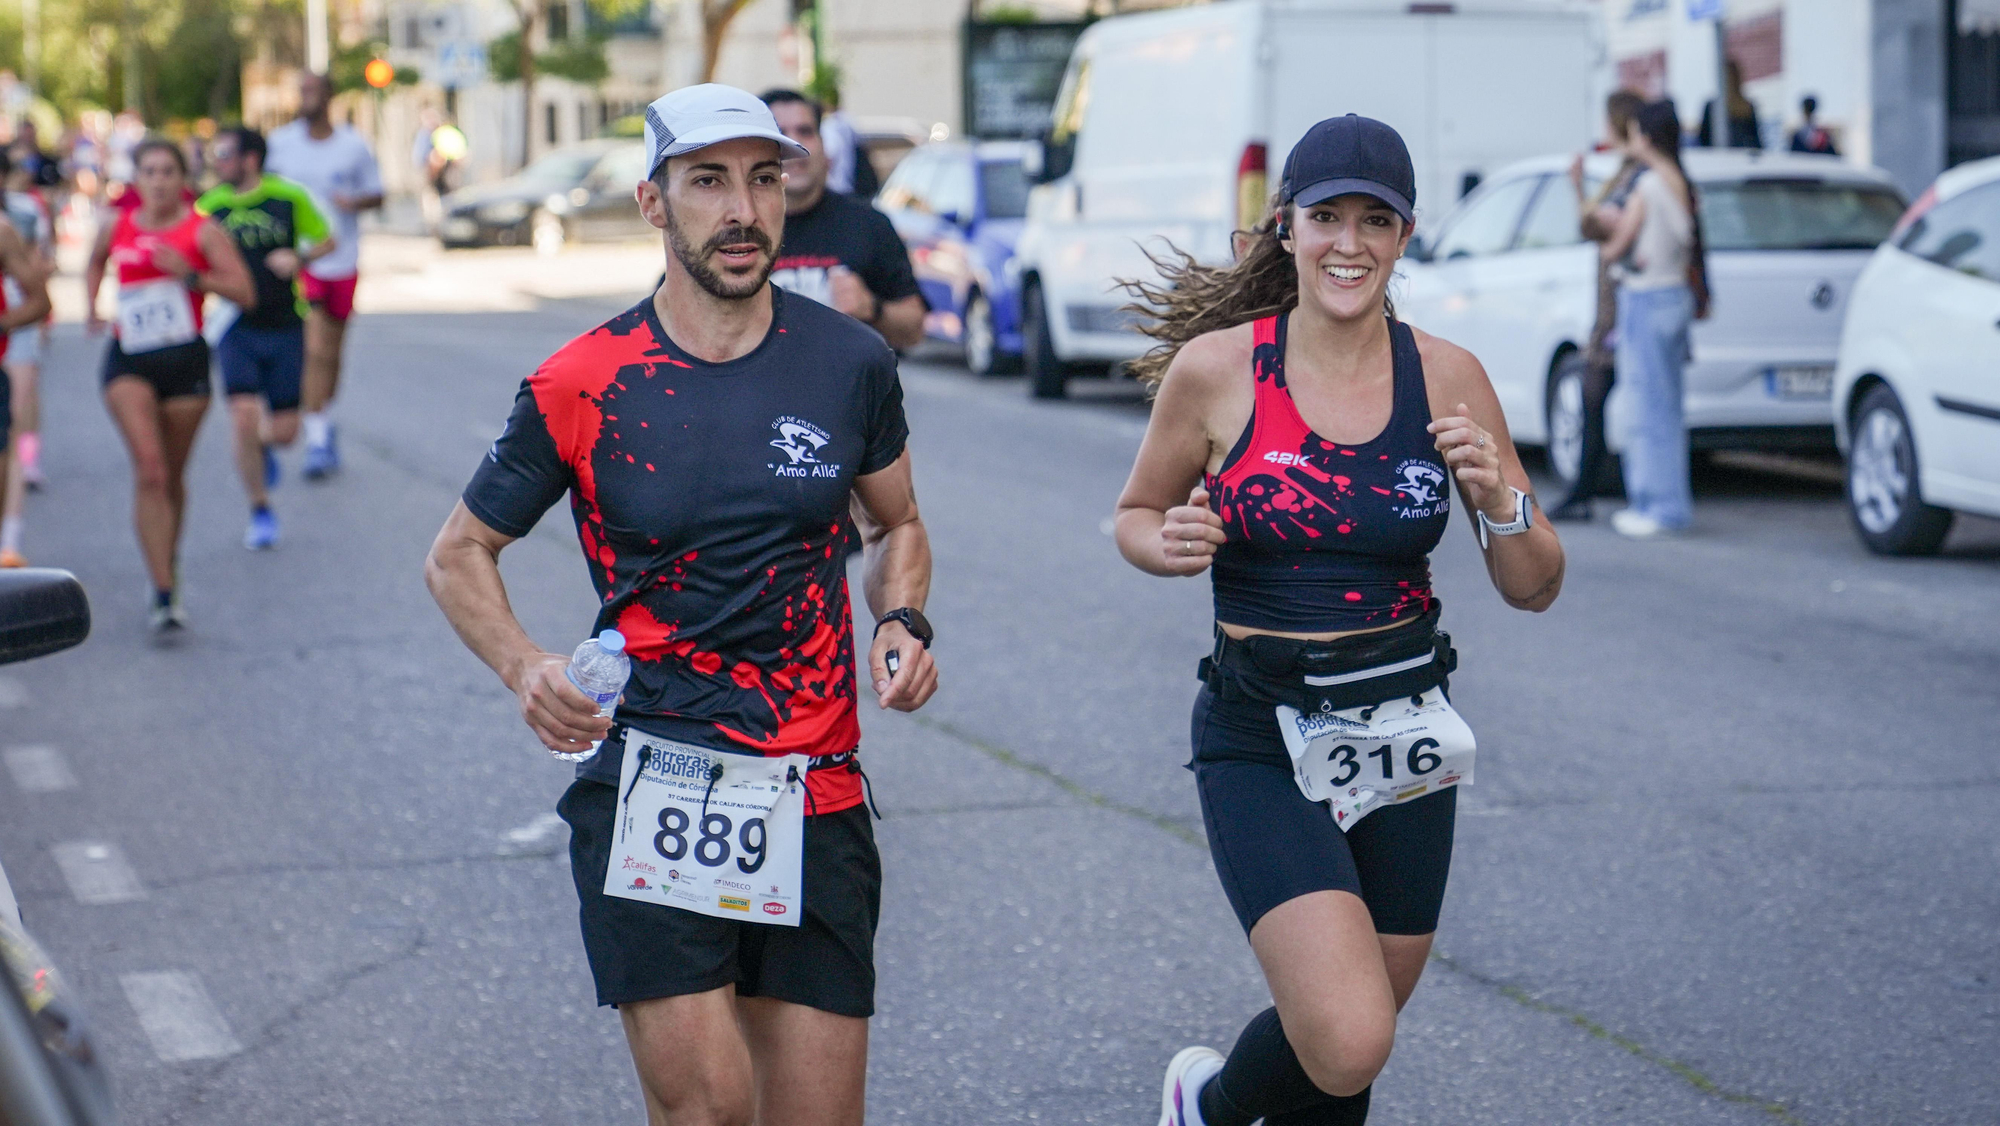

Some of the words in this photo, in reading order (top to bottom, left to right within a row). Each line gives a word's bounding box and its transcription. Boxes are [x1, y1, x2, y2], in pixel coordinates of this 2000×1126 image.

[771, 415, 786, 430] CLUB
[796, 419, 830, 440] ATLETISMO
[1263, 450, 1311, 467] 42K
[1395, 460, 1409, 474] CLUB
[1419, 460, 1445, 475] ATLETISMO
[767, 463, 807, 477] "Amo
[811, 463, 840, 478] Allá"
[1392, 506, 1431, 519] "Amo
[645, 739, 674, 751] CIRCUITO
[674, 746, 711, 760] PROVINCIAL
[649, 747, 711, 769] arreras
[643, 760, 713, 781] populare
[1327, 737, 1442, 788] 316
[640, 772, 677, 787] Diputación
[679, 781, 688, 790] de
[676, 795, 706, 804] CARRERA
[718, 800, 745, 809] CALIFAS
[745, 802, 772, 813] CÓRDOBA
[653, 807, 767, 875] 889
[630, 861, 657, 873] califas
[722, 879, 752, 891] IMDECO
[720, 897, 748, 907] SALADITOS
